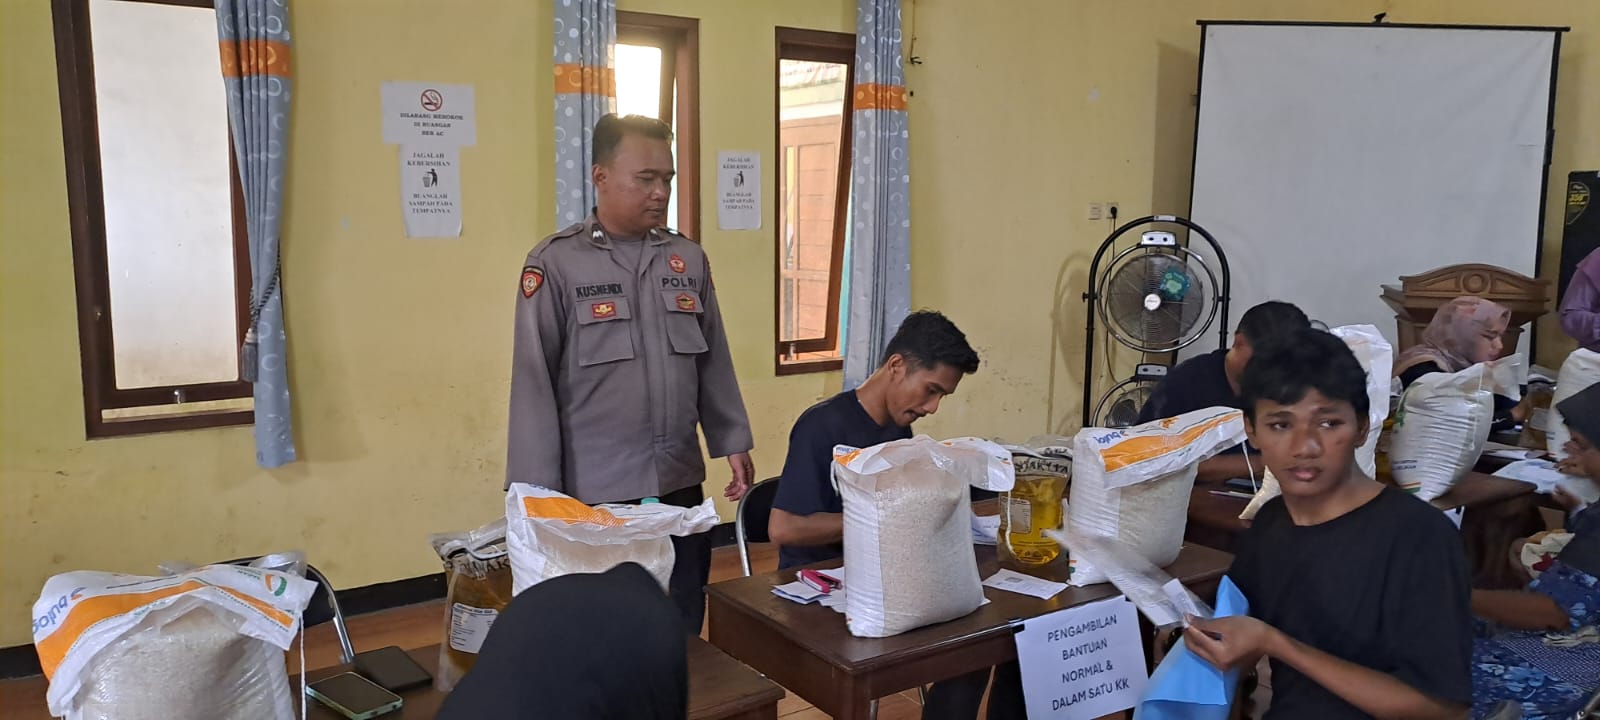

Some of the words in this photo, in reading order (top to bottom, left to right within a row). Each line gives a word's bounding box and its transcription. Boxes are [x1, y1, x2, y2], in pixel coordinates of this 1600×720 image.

[661, 276, 697, 289] POLRI
[1048, 614, 1117, 642] PENGAMBILAN
[1062, 637, 1108, 661] BANTUAN
[1062, 661, 1104, 684] NORMAL
[1105, 659, 1113, 671] &
[1052, 690, 1087, 711] DALAM
[1088, 680, 1113, 700] SATU
[1114, 677, 1130, 692] KK
